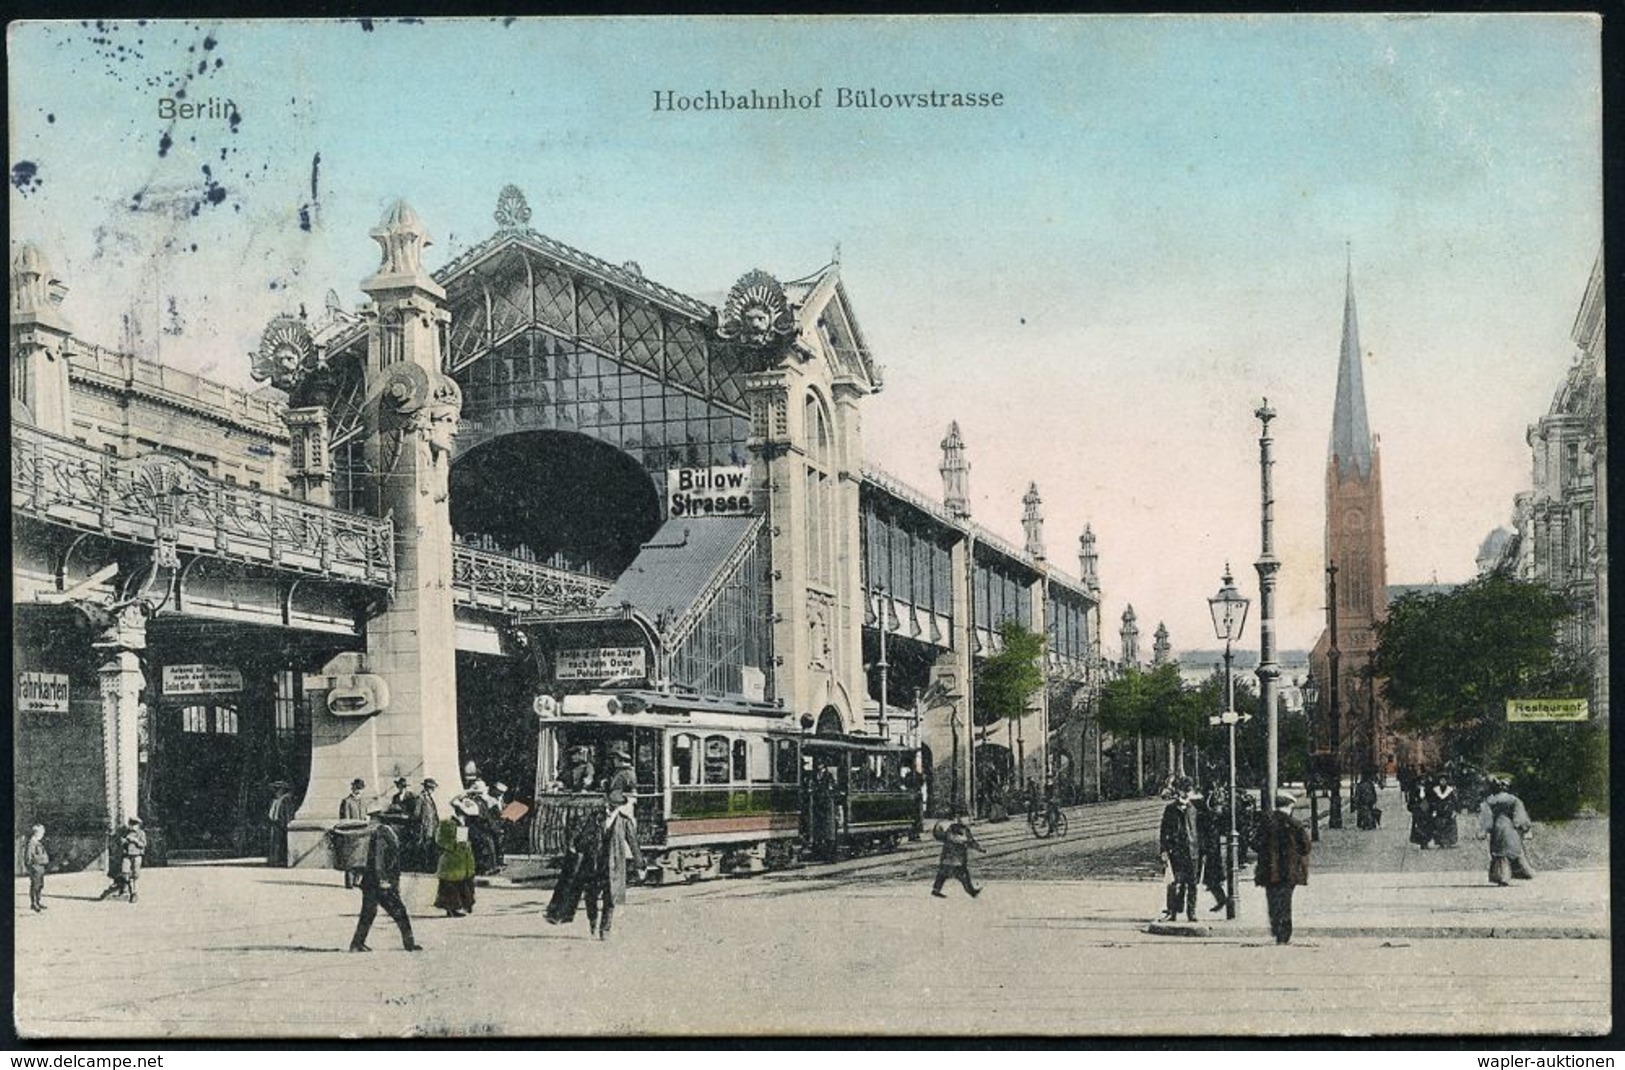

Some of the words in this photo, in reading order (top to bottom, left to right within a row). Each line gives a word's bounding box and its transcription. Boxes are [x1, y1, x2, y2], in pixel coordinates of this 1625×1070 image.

[671, 493, 752, 516] Strasse
[18, 672, 68, 701] Fahrkarten
[1514, 702, 1582, 713] Restaurant
